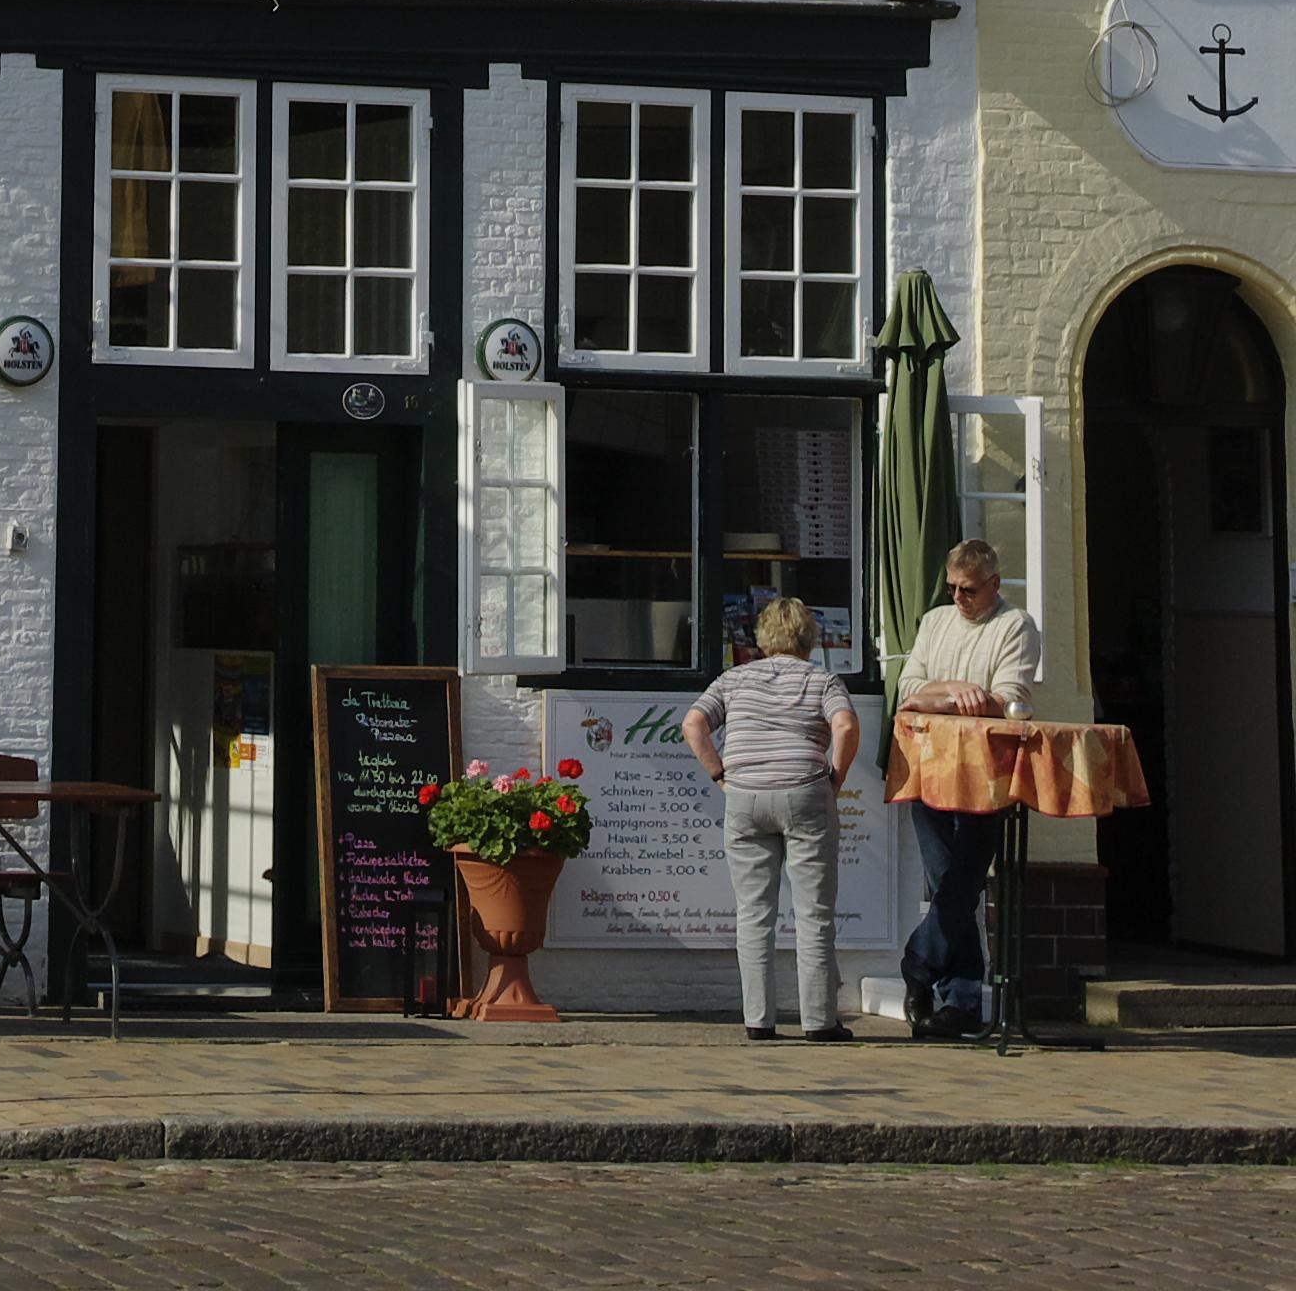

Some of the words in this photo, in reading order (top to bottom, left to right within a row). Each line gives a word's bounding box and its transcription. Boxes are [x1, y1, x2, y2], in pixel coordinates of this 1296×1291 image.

[4, 360, 43, 369] HOLSTEN
[493, 361, 531, 371] HOLSTEN
[361, 691, 410, 710] Trattoria
[614, 770, 641, 782] Käse
[654, 770, 683, 782] 2,50
[686, 771, 697, 782] €
[353, 786, 417, 805] durchgehend
[600, 785, 654, 798] Schinken
[667, 786, 697, 798] 3,00
[700, 786, 711, 798] €
[607, 801, 646, 813] Salami
[659, 802, 690, 814] 3,00
[692, 802, 703, 813] €
[681, 818, 712, 829] 3,00
[607, 833, 648, 844] Hawaii
[661, 833, 689, 845] 3,50
[692, 833, 703, 844] €
[578, 847, 634, 861] hunfisch,
[637, 848, 684, 860] Zwiebel
[697, 849, 726, 860] 3,50
[601, 864, 652, 875] Krabben
[665, 865, 696, 876] 3,00
[699, 865, 709, 876] €
[616, 890, 638, 903] extra
[648, 891, 671, 903] 0,50
[673, 890, 681, 903] €
